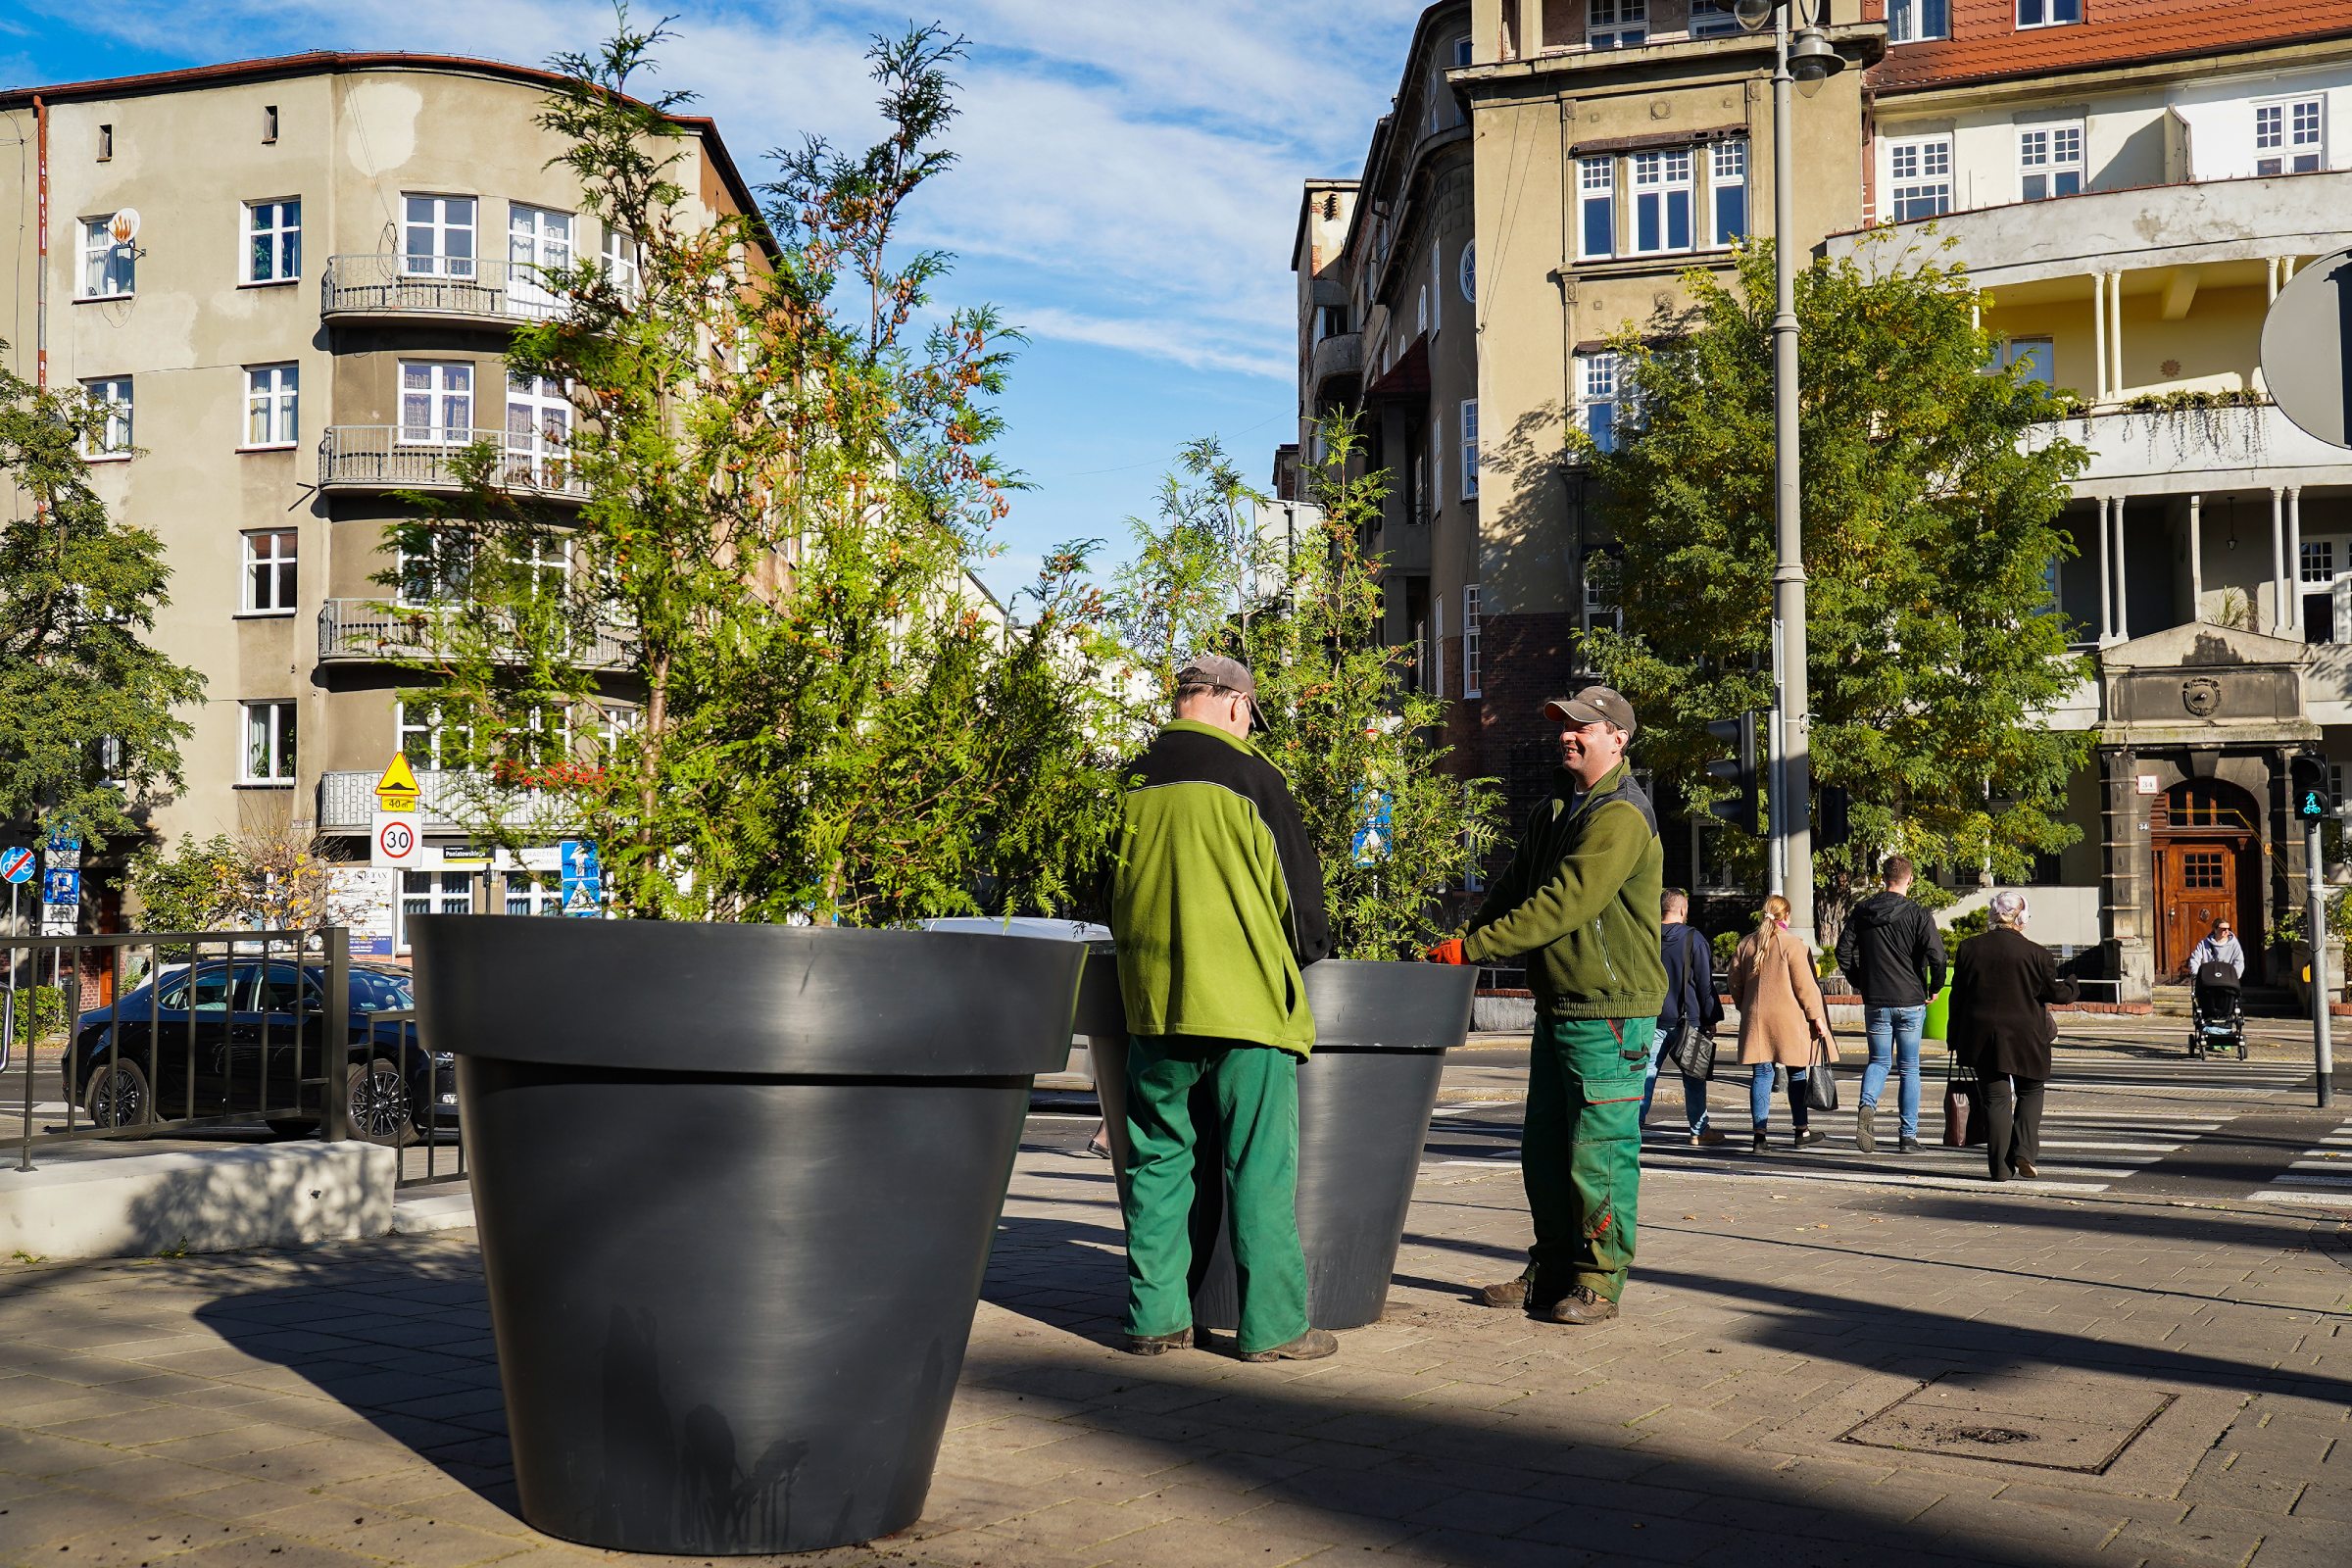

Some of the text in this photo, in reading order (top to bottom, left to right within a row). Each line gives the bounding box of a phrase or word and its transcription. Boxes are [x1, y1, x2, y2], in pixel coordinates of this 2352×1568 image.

[389, 799, 401, 808] 40
[386, 831, 410, 849] 30
[53, 873, 73, 899] P
